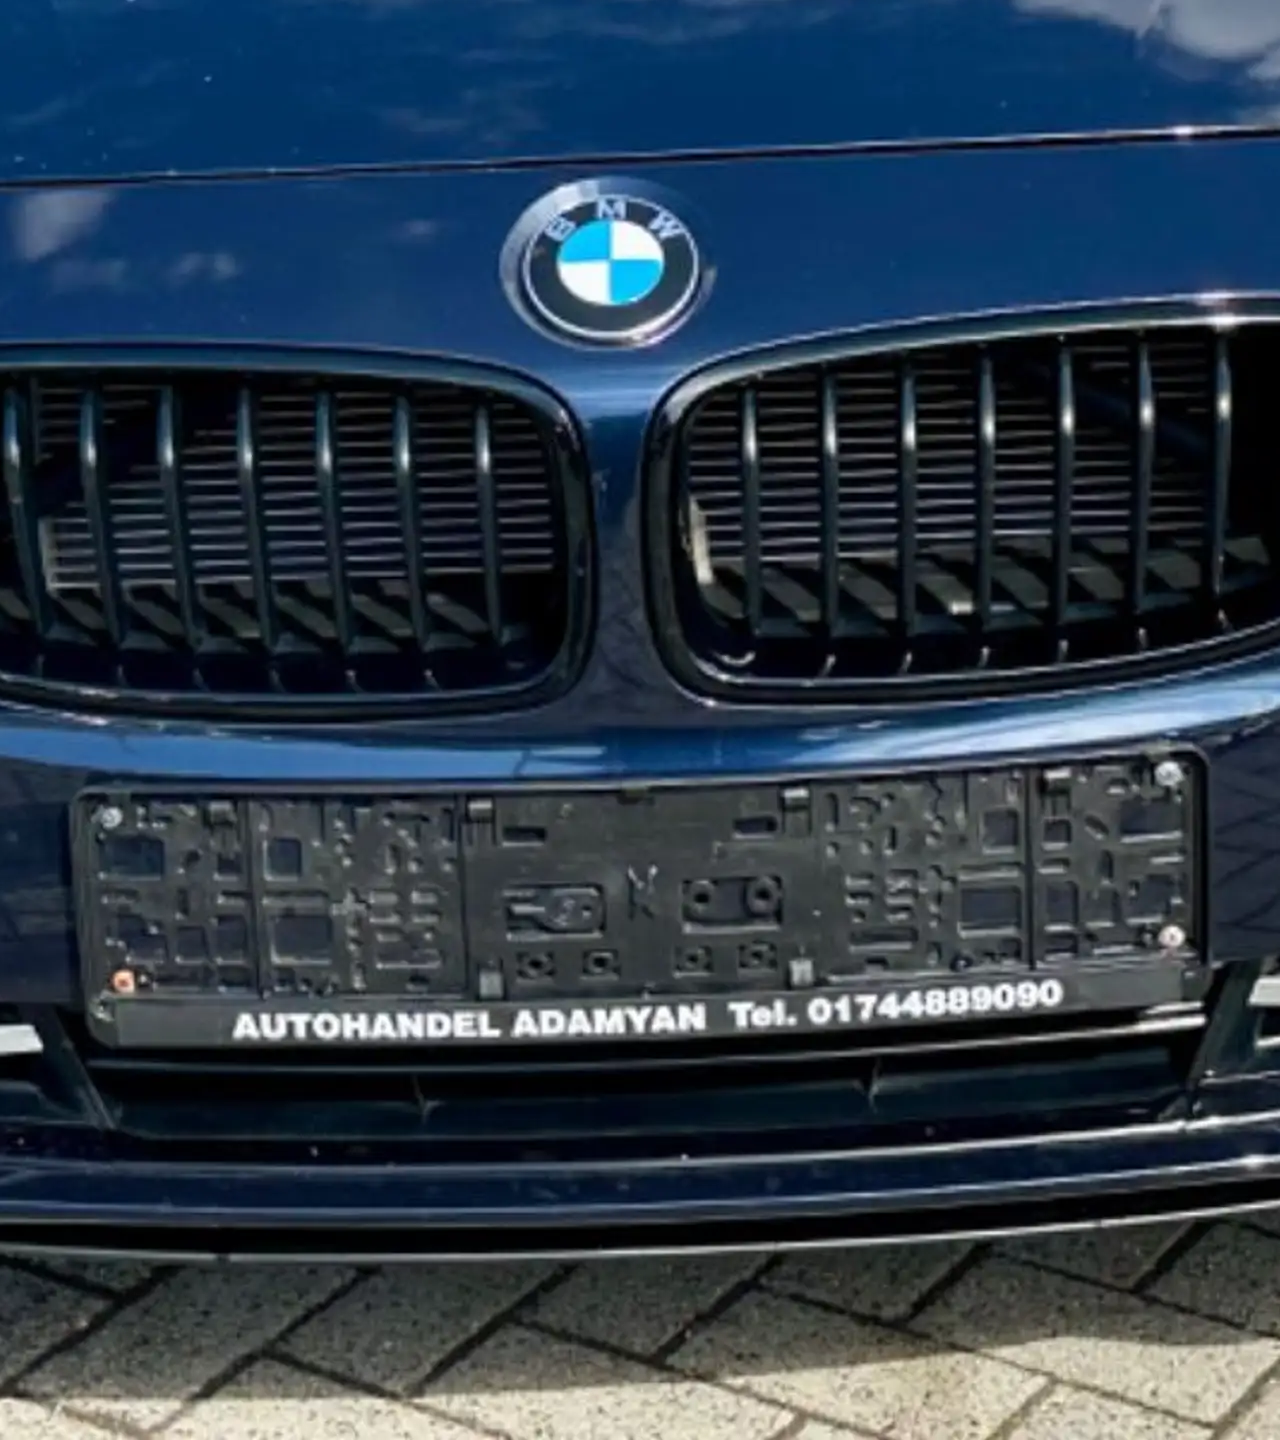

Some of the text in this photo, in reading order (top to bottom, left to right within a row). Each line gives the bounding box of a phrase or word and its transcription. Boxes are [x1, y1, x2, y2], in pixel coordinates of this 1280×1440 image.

[544, 197, 683, 241] BMW
[232, 979, 1064, 1040] AUTOHANDEL ADAMYAN Tel. 01744889090
